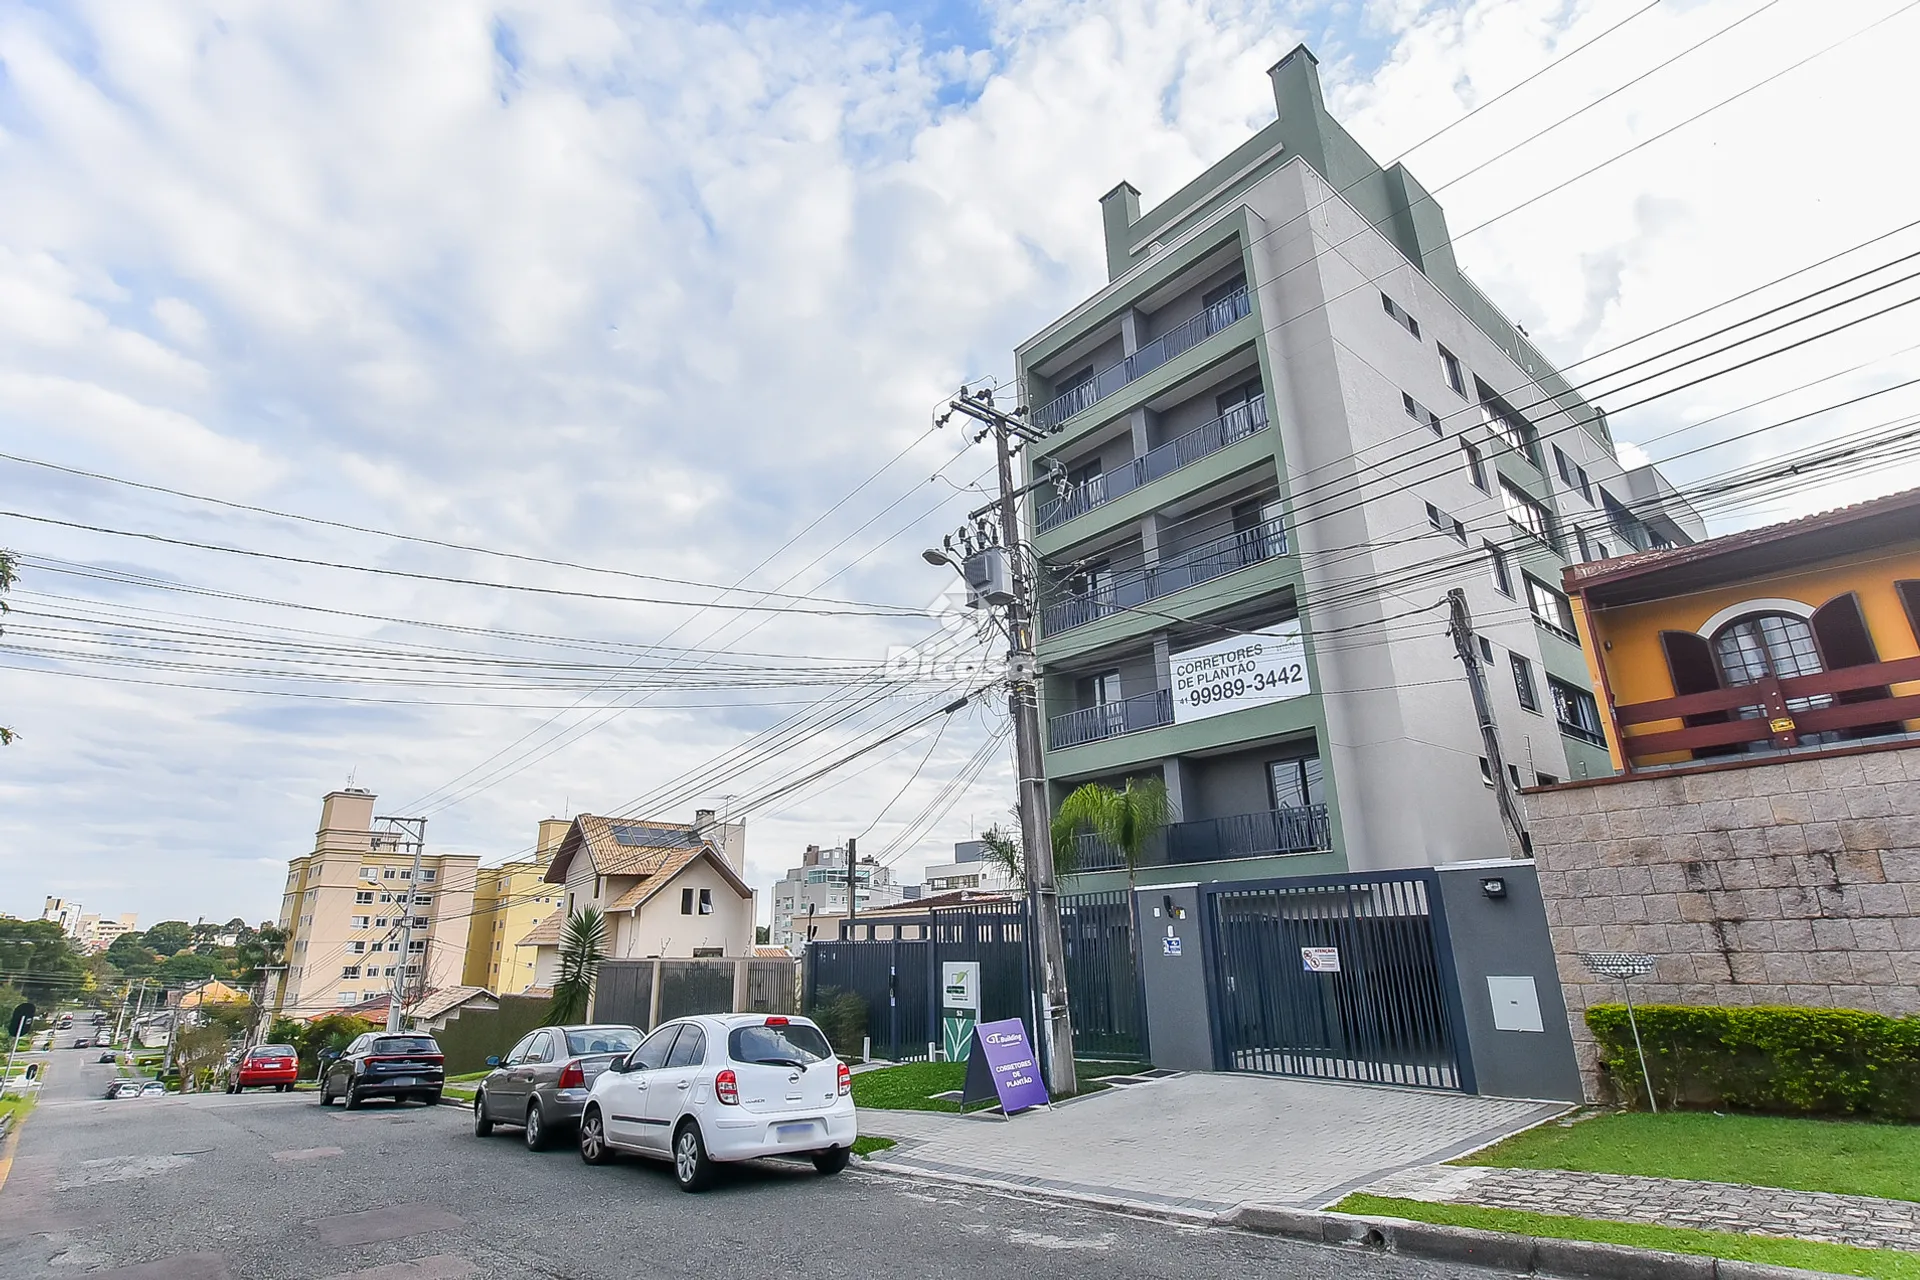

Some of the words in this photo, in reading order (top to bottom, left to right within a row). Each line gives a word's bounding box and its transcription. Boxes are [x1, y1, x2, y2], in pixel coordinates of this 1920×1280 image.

[1176, 643, 1263, 677] CORRETORES
[1178, 678, 1194, 690] DE
[1197, 660, 1256, 686] PLANTÃO
[1190, 664, 1303, 707] 99989-3442
[995, 1060, 1032, 1073] CORRETORES
[1006, 1077, 1032, 1087] PLANTÃO
